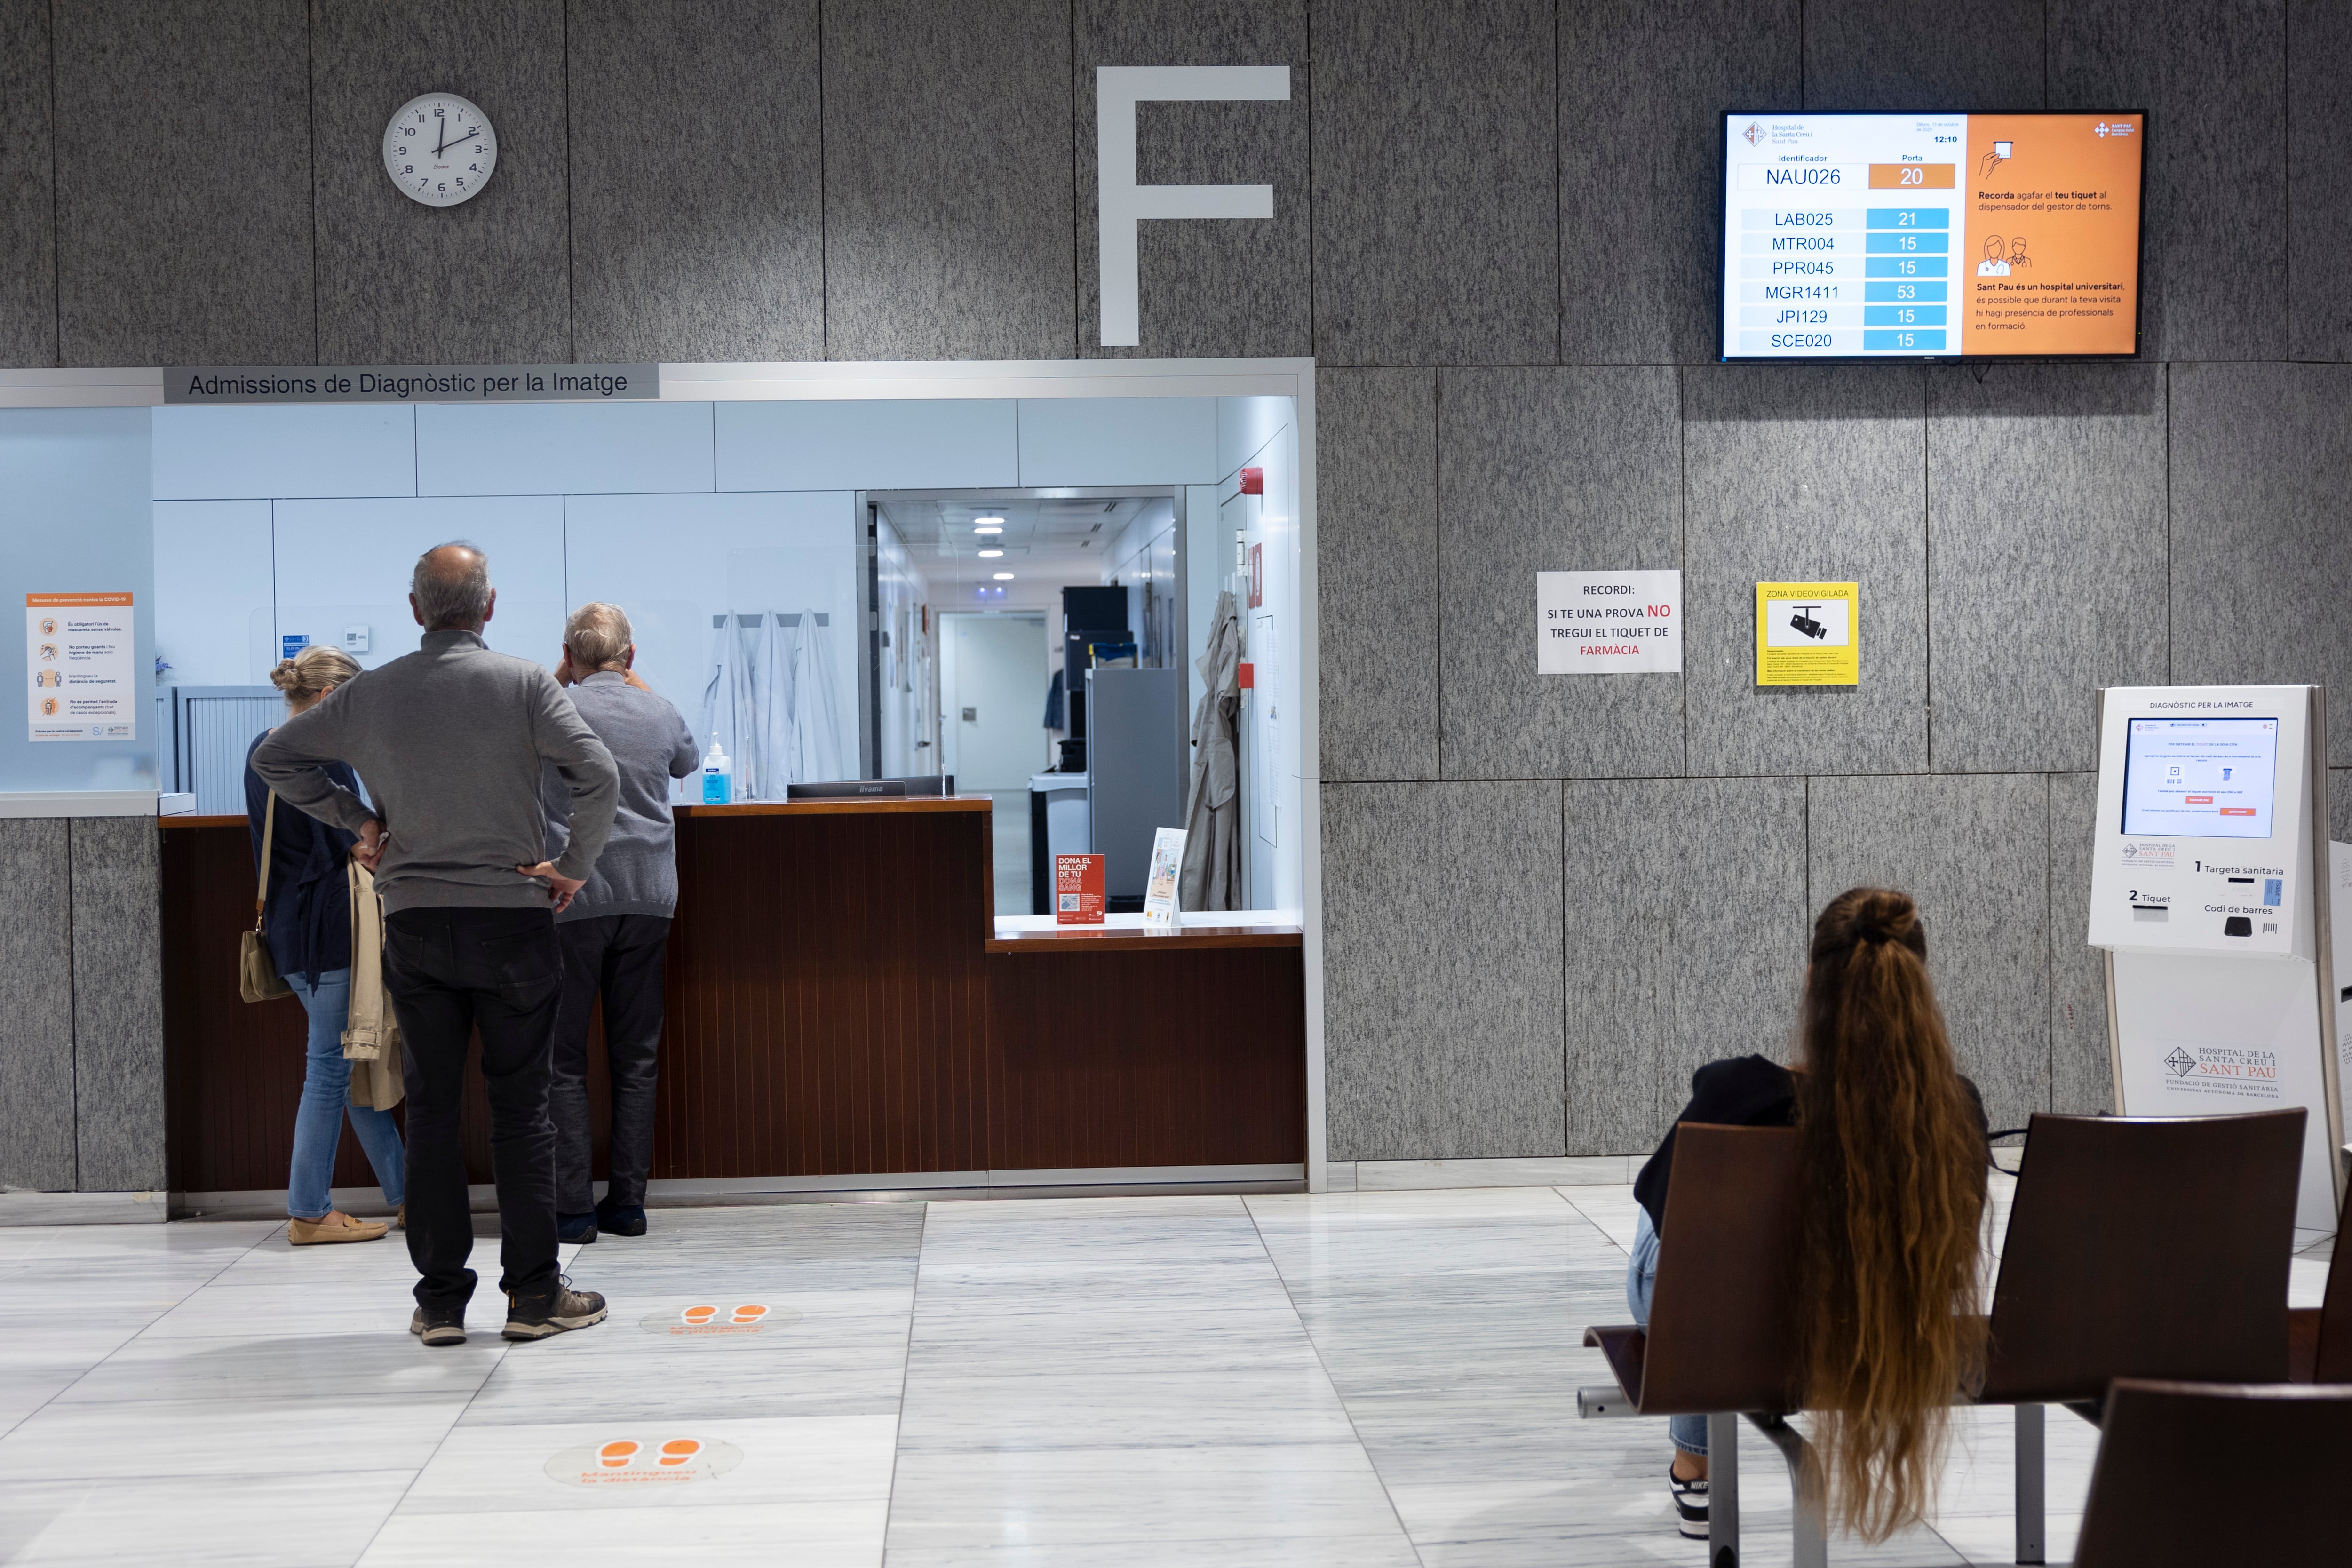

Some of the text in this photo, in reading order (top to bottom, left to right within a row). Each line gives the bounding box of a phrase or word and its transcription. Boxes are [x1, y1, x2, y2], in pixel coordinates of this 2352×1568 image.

[419, 114, 425, 123] 11
[434, 109, 445, 117] 12
[405, 128, 416, 136] 10
[468, 127, 476, 135] 2
[399, 147, 407, 155] 9
[405, 165, 413, 174] 8
[469, 163, 477, 172] 4
[456, 177, 464, 186] 5
[1766, 169, 1840, 185] NAU026
[1900, 168, 1923, 185] 20
[421, 178, 429, 187] 7
[437, 183, 445, 191] 6
[2017, 191, 2043, 201] agafar
[2071, 191, 2097, 200] tiquet
[1097, 65, 1290, 346] F
[1979, 203, 2029, 212] dispensador
[1775, 213, 1833, 226] LAB025
[1899, 213, 1916, 225] 21
[1772, 238, 1835, 250] MTR004
[1899, 237, 1916, 250] 15
[1773, 262, 1834, 274] PPR045
[1899, 261, 1916, 274] 15
[1766, 286, 1838, 299] MGR1411
[1897, 285, 1915, 299] 53
[2040, 283, 2074, 292] hospital
[2075, 282, 2125, 291] universitari,
[1988, 296, 2022, 305] possible
[1776, 310, 1827, 323] JPI129
[1898, 310, 1915, 322] 15
[1986, 309, 2003, 318] hagi
[2005, 309, 2045, 318] presència
[2059, 309, 2114, 318] professionals
[1771, 334, 1832, 347] SCE020
[1897, 334, 1914, 347] 15
[189, 372, 628, 398] Admissions de Diagnòstic per la Imatge
[1583, 585, 1635, 595] RECORDI:
[1548, 605, 1670, 619] SI TE UNA PROVA NO
[1551, 627, 1668, 638] TREGUI EL TIQUET DE
[1581, 644, 1639, 655] FARMÀCIA
[2195, 861, 2283, 876] 1 Targeta sanitaria
[2129, 890, 2171, 904] 2 Tiquet
[2205, 904, 2273, 915] Codi de barres
[2199, 1047, 2244, 1058] HOSPITAL
[2199, 1055, 2234, 1064] SANTA
[2200, 1063, 2277, 1078] SANT PAU
[581, 1470, 697, 1478] Mantingueu
[1691, 1481, 1709, 1490] NIKE
